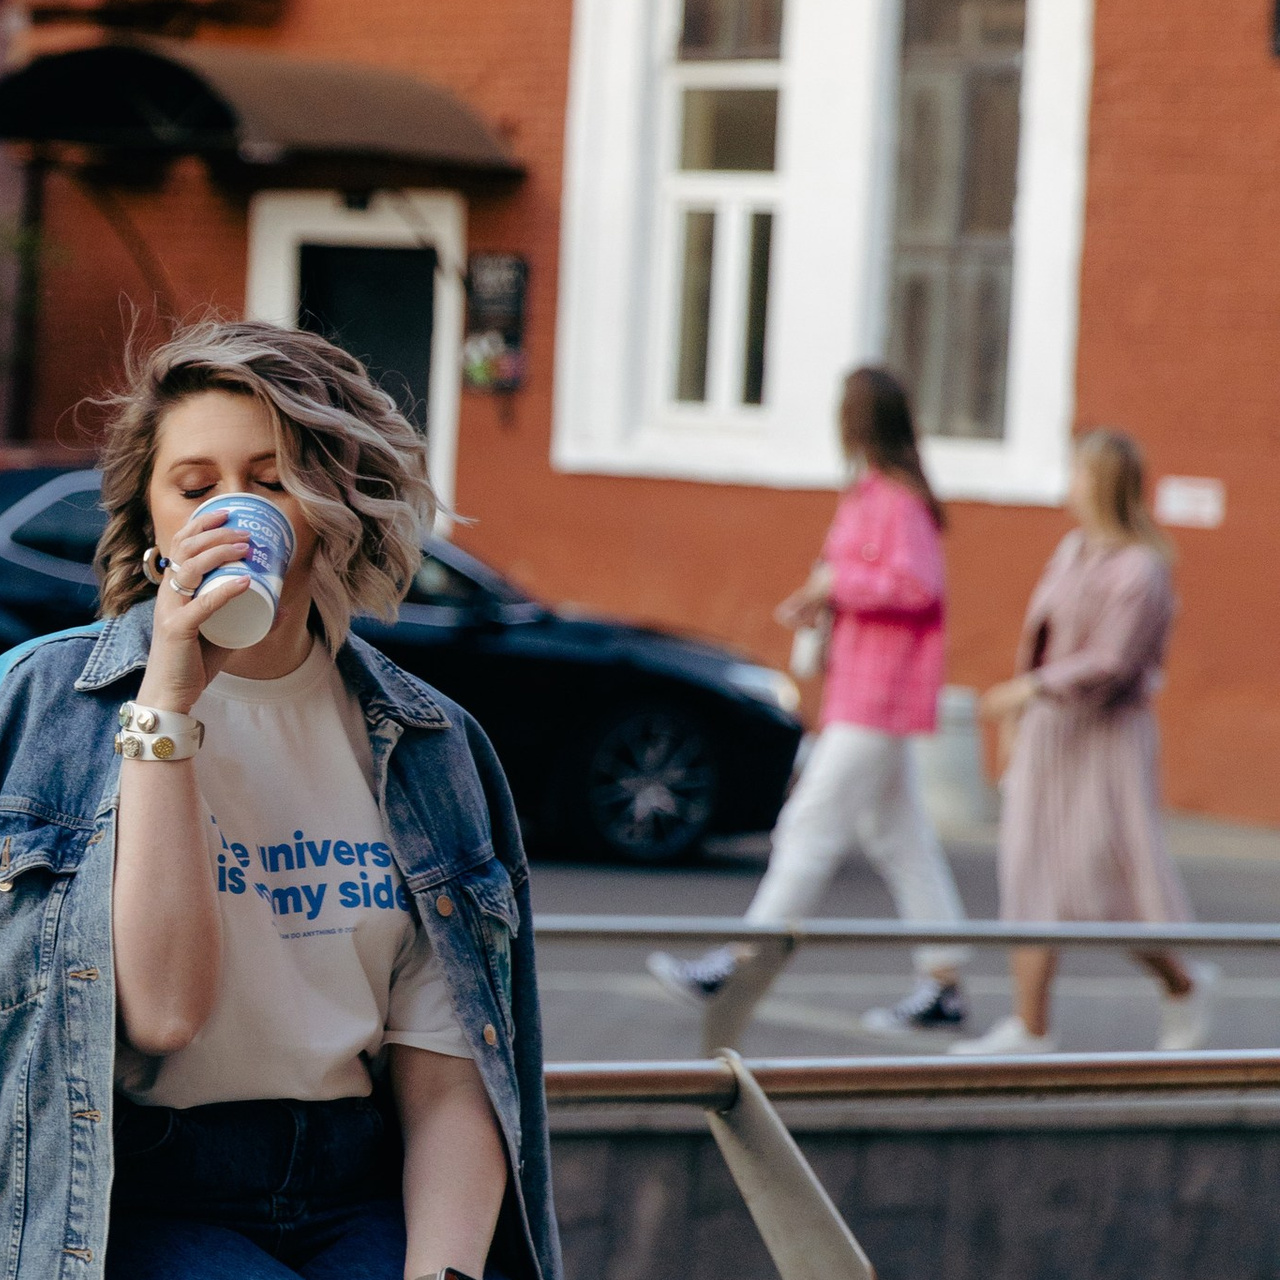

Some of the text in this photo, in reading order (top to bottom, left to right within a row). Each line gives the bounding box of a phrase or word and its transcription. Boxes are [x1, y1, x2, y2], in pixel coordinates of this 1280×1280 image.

[237, 518, 280, 546] КОФЕ
[252, 555, 272, 572] FFEE
[253, 548, 268, 560] MG
[257, 829, 391, 873] nivers
[217, 854, 246, 894] is
[271, 882, 327, 920] my
[339, 871, 411, 911] side
[302, 928, 336, 938] ANYTHING
